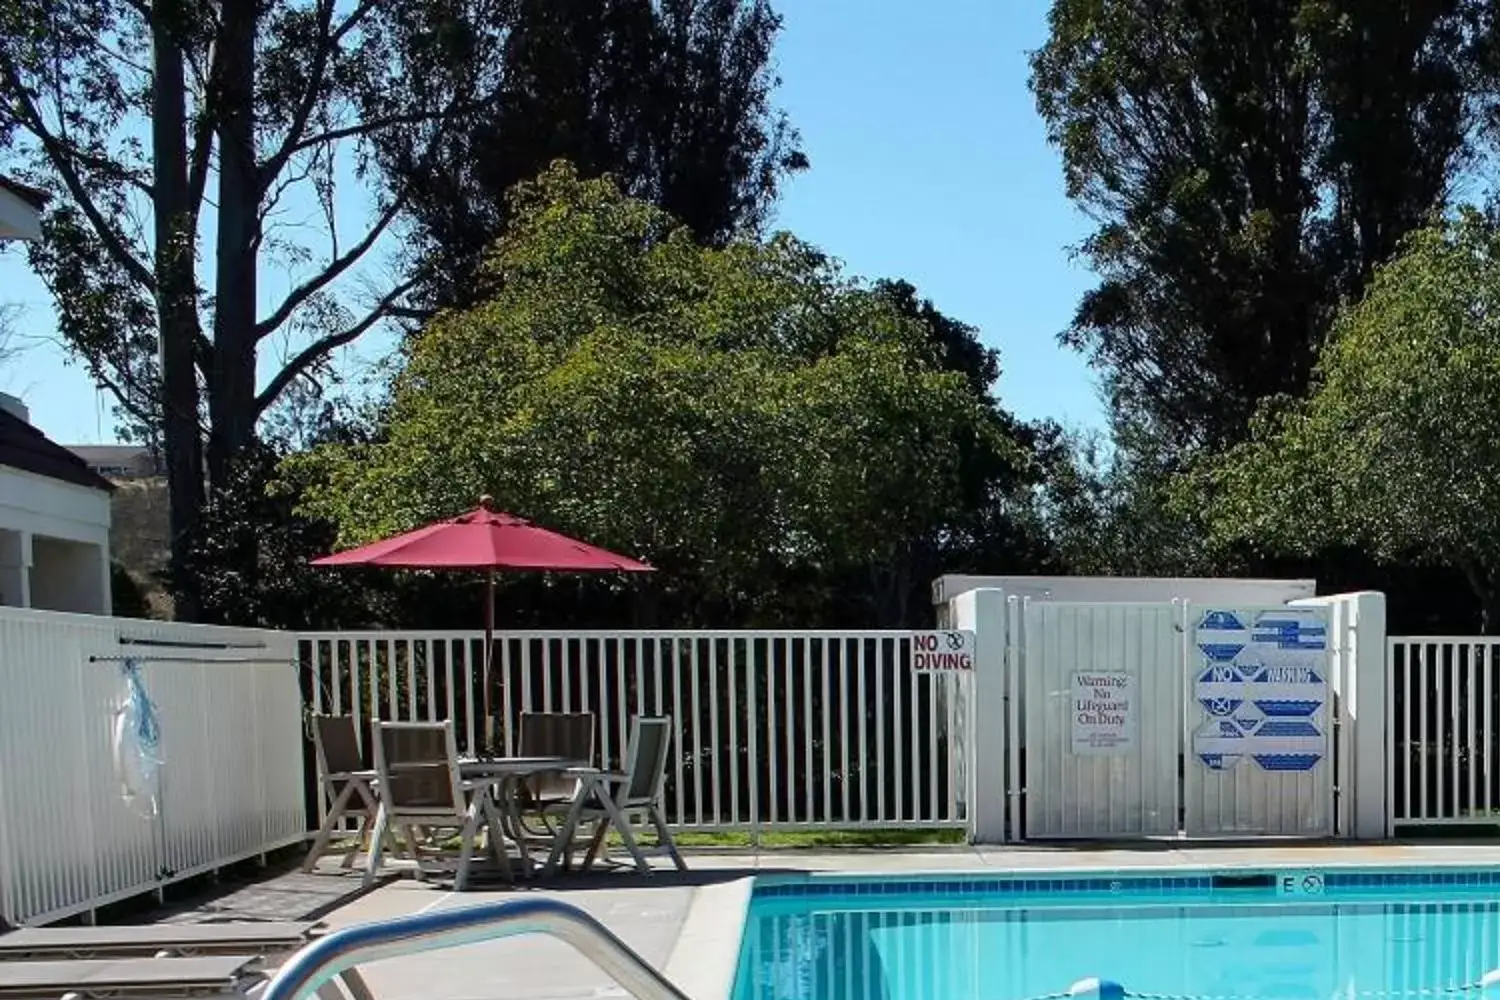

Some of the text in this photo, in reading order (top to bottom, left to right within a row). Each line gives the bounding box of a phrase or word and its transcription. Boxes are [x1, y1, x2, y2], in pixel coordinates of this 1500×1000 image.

[914, 635, 938, 651] NO
[914, 653, 972, 669] DIVING
[1212, 667, 1232, 681] NO
